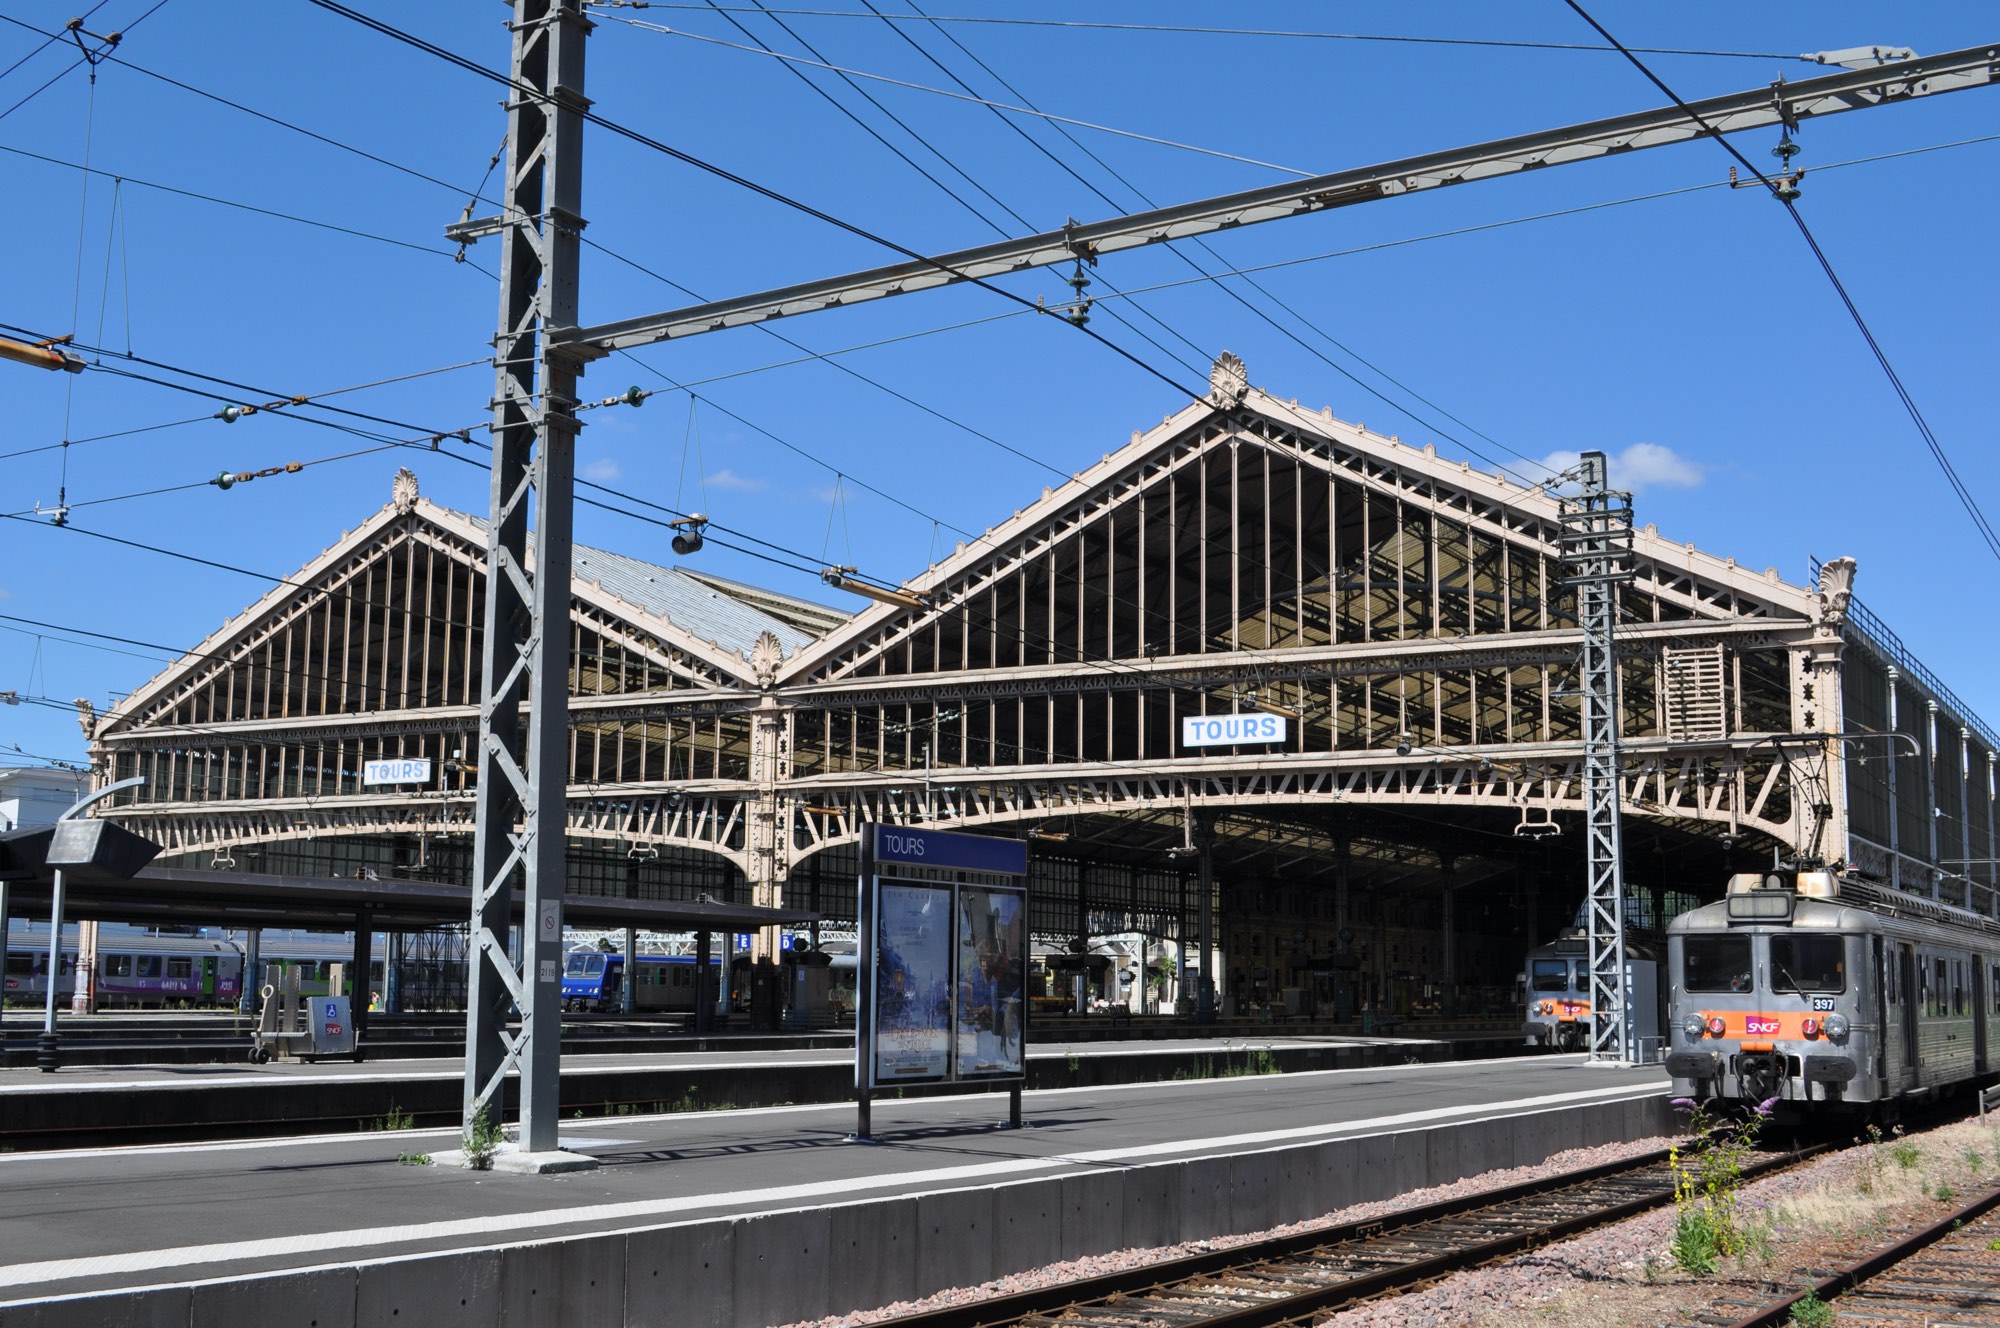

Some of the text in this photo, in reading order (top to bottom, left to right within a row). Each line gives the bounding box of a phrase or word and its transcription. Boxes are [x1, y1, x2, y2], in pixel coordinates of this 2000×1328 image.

[1191, 717, 1276, 740] TOURS
[369, 762, 424, 780] TOURS
[885, 834, 925, 856] TOURS
[741, 938, 748, 948] E
[783, 940, 790, 949] D
[1814, 999, 1834, 1010] 397
[326, 1027, 342, 1035] SNCF
[1747, 1022, 1780, 1033] SNCF
